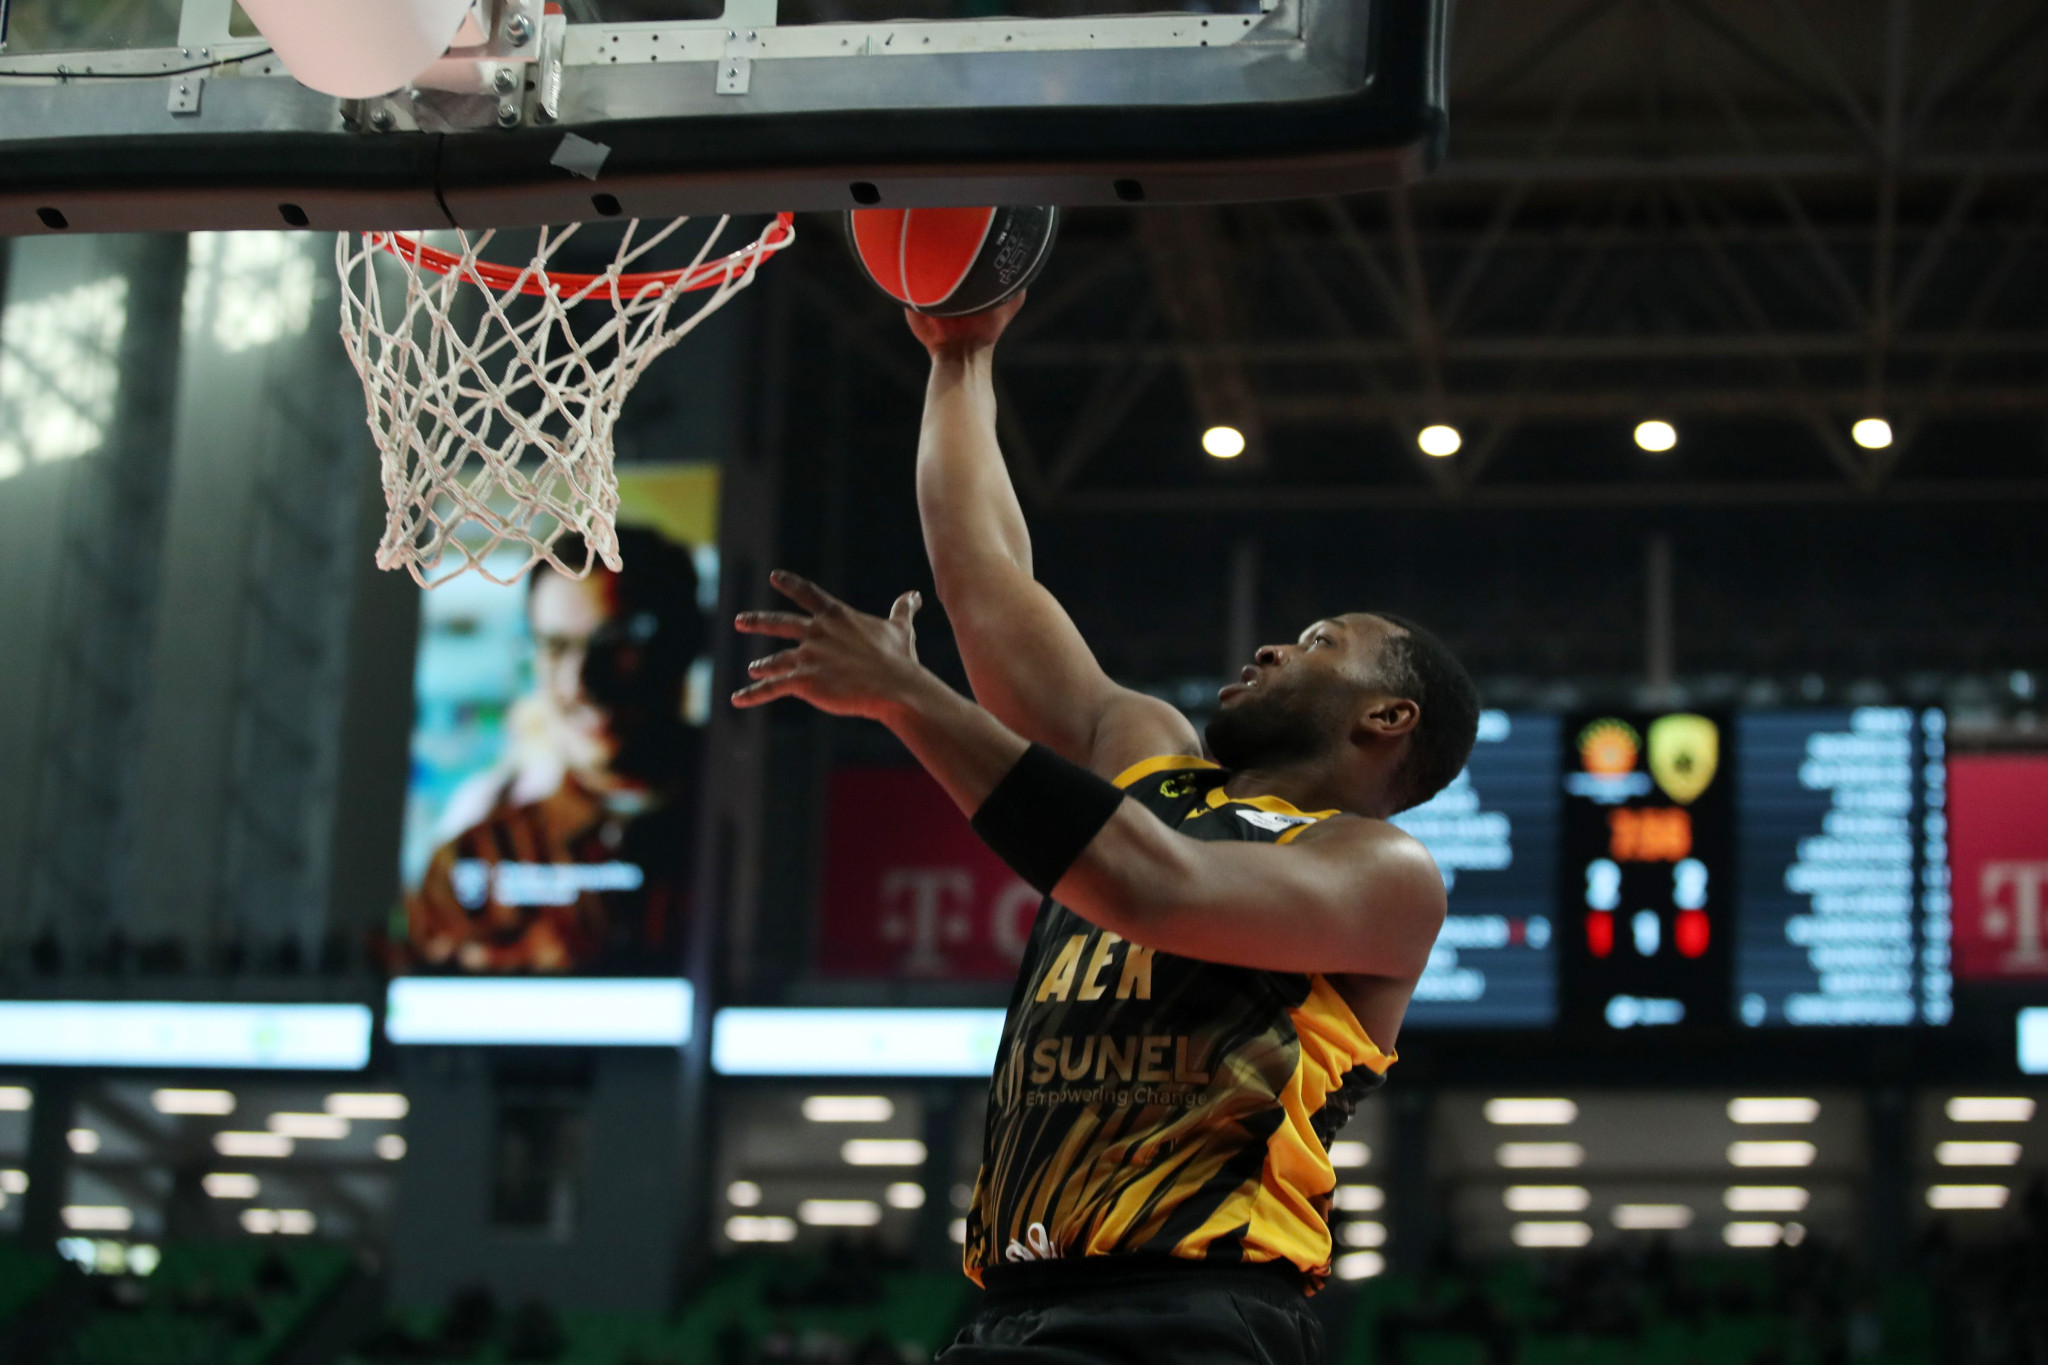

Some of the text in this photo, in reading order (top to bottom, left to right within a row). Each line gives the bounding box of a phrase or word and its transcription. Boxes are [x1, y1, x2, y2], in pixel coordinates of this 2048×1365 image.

[1035, 932, 1156, 1002] AEK
[1031, 1036, 1210, 1084] SUNEL
[1027, 1085, 1208, 1107] Empowering Change
